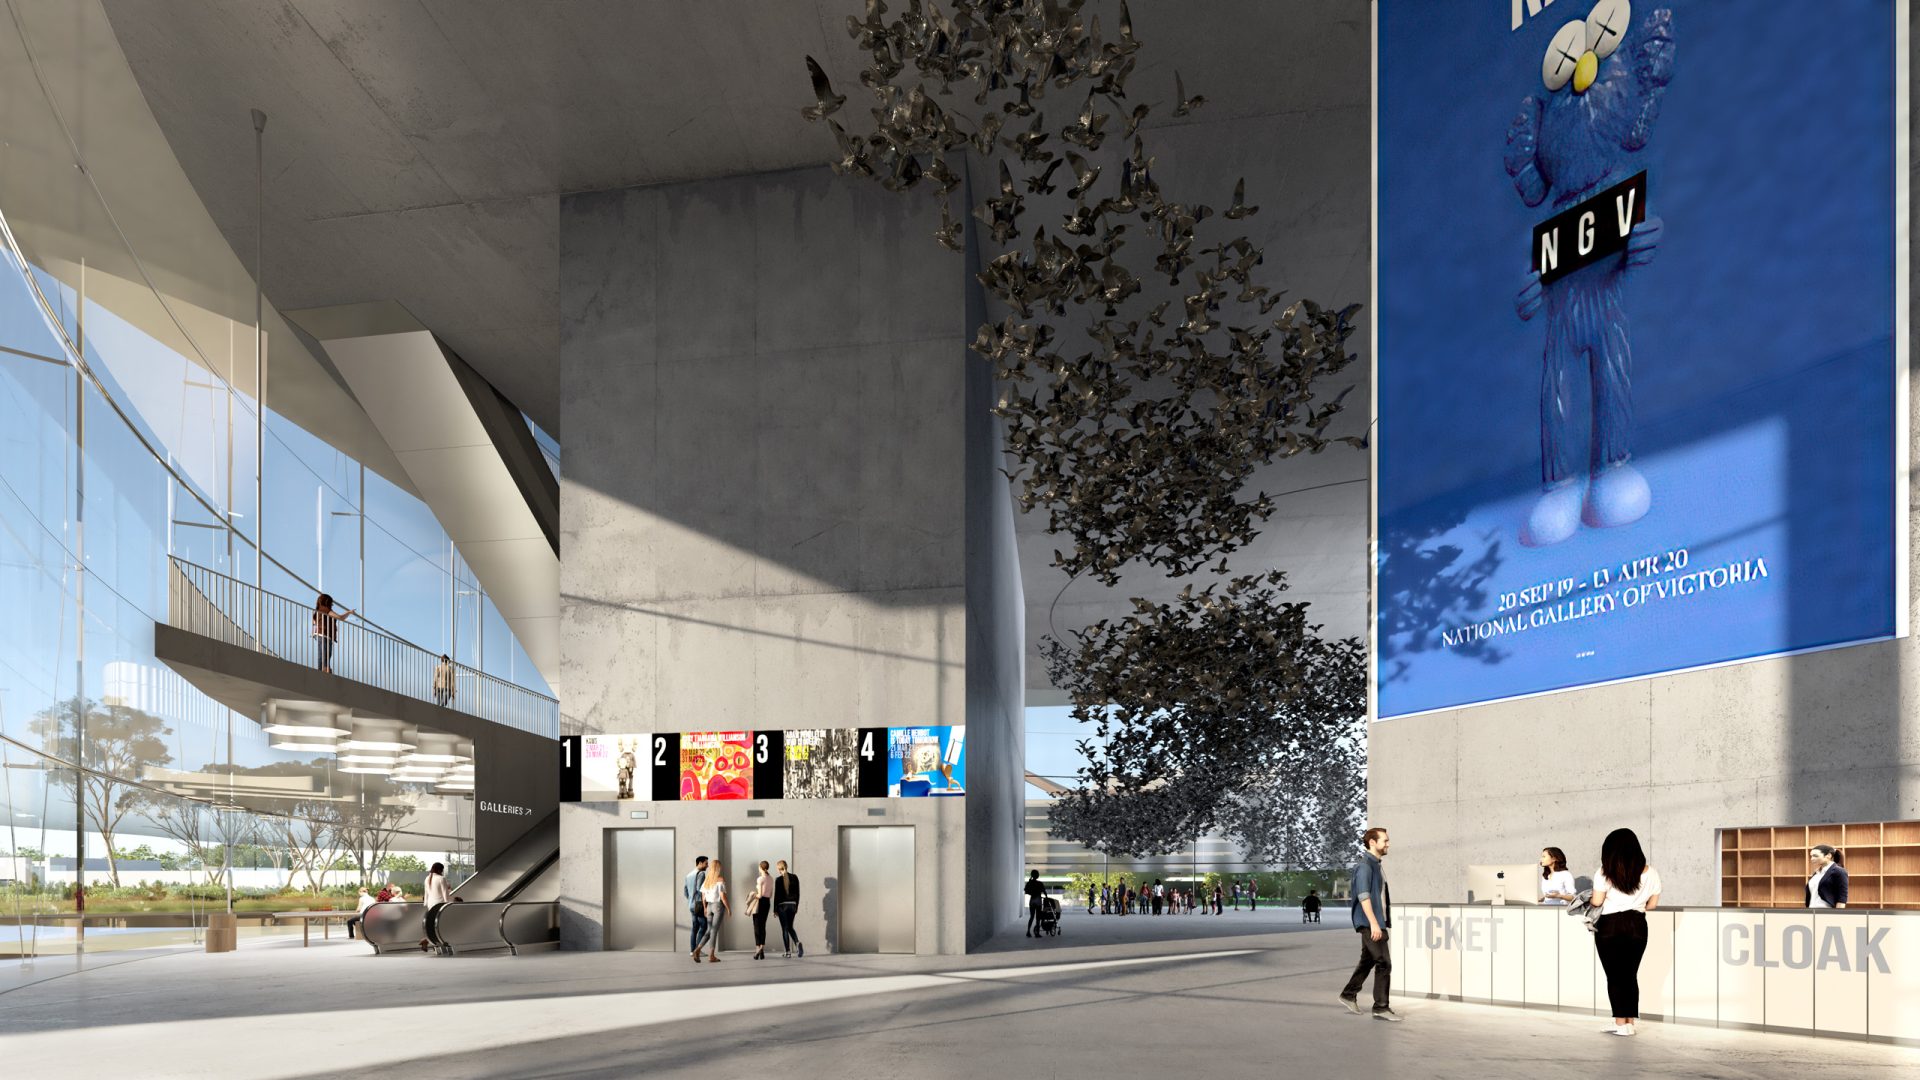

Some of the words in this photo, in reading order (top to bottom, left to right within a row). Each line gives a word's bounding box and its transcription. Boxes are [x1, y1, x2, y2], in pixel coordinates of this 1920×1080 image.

[1442, 613, 1528, 648] NATIONAL
[1530, 590, 1620, 628] GALLERY
[1623, 583, 1656, 608] OF
[1656, 557, 1768, 599] VICTORIA
[562, 738, 571, 768] 1
[654, 737, 667, 766] 2
[756, 734, 769, 764] 3
[861, 731, 875, 761] 4
[480, 801, 523, 815] GALLERIES
[1397, 915, 1504, 953] TICKET
[1722, 923, 1892, 974] CLOAK
